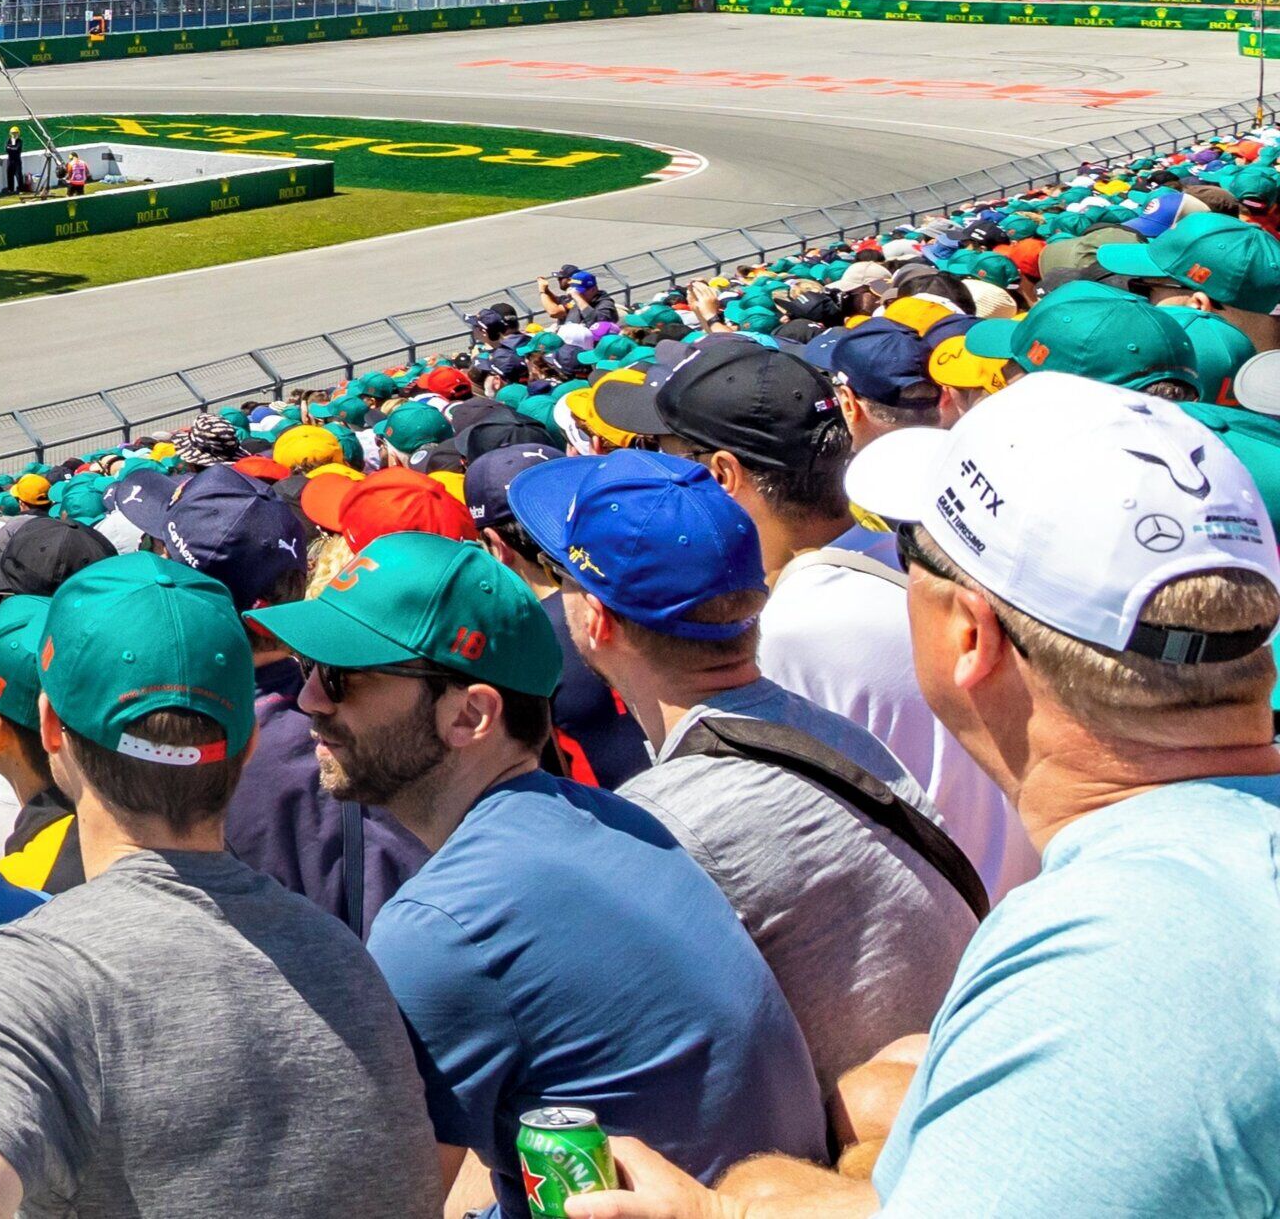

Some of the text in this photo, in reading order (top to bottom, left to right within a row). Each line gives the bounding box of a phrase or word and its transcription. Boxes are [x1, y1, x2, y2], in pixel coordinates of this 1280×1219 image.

[770, 7, 804, 15] ROLEX
[946, 13, 984, 23] ROLEX
[1009, 16, 1048, 24] ROLEX
[32, 54, 51, 62] ROLEX
[80, 49, 99, 57] ROLEX
[60, 116, 621, 168] ROLEX
[279, 186, 305, 199] ROLEX
[211, 196, 239, 211] ROLEX
[137, 208, 168, 222] ROLEX
[56, 221, 88, 236] ROLEX
[969, 471, 1005, 518] FTX
[938, 495, 955, 518] GRAN
[952, 515, 987, 552] TURISMO
[167, 521, 199, 568] CarNext
[450, 626, 489, 661] 18
[524, 1129, 596, 1193] ORIGINA
